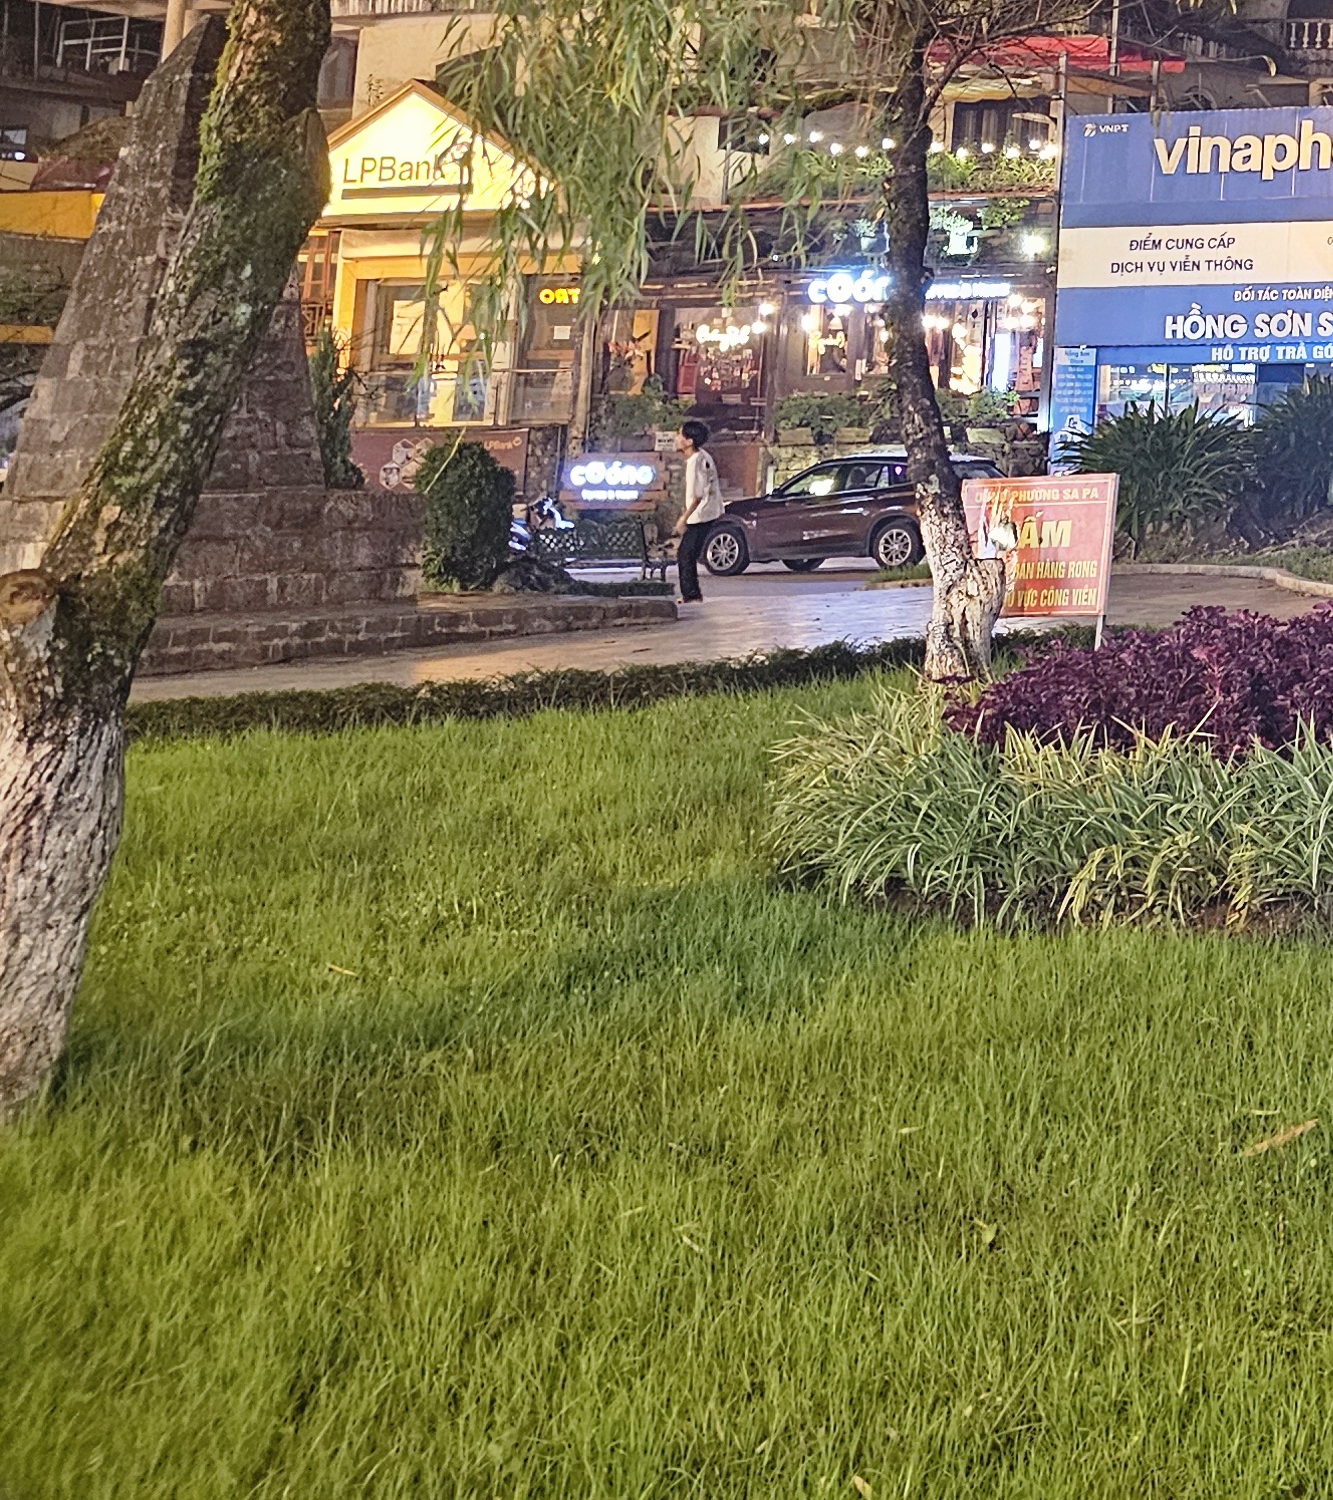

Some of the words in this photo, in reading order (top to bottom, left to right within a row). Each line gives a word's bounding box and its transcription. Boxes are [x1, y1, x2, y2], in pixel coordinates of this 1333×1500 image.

[1099, 124, 1129, 132] VNPT
[343, 154, 447, 184] LPBank
[1129, 232, 1162, 251] ĐIỂM
[1165, 237, 1204, 250] CUNG
[1207, 231, 1236, 249] CẤP
[1110, 261, 1144, 276] DỊCH
[1147, 261, 1166, 275] VỤ
[1169, 255, 1200, 272] VIỄN
[1205, 256, 1254, 271] THÔNG
[1234, 286, 1255, 302] ĐỐI
[1257, 286, 1279, 301] TÁC
[1282, 285, 1312, 301] TOÀN
[1165, 302, 1248, 340] HỒNG
[1254, 309, 1313, 338] SƠN
[1239, 344, 1272, 363] TRỢ
[1275, 341, 1308, 360] TRẢ
[1062, 488, 1079, 500] SA
[1082, 487, 1099, 500] PA
[1017, 510, 1072, 549] ẤM
[1036, 559, 1066, 580] HÀNG
[1067, 560, 1098, 579] RONG
[1017, 588, 1039, 610] VỰC
[1039, 585, 1069, 608] CÔNG
[1072, 584, 1098, 606] VIÊN
